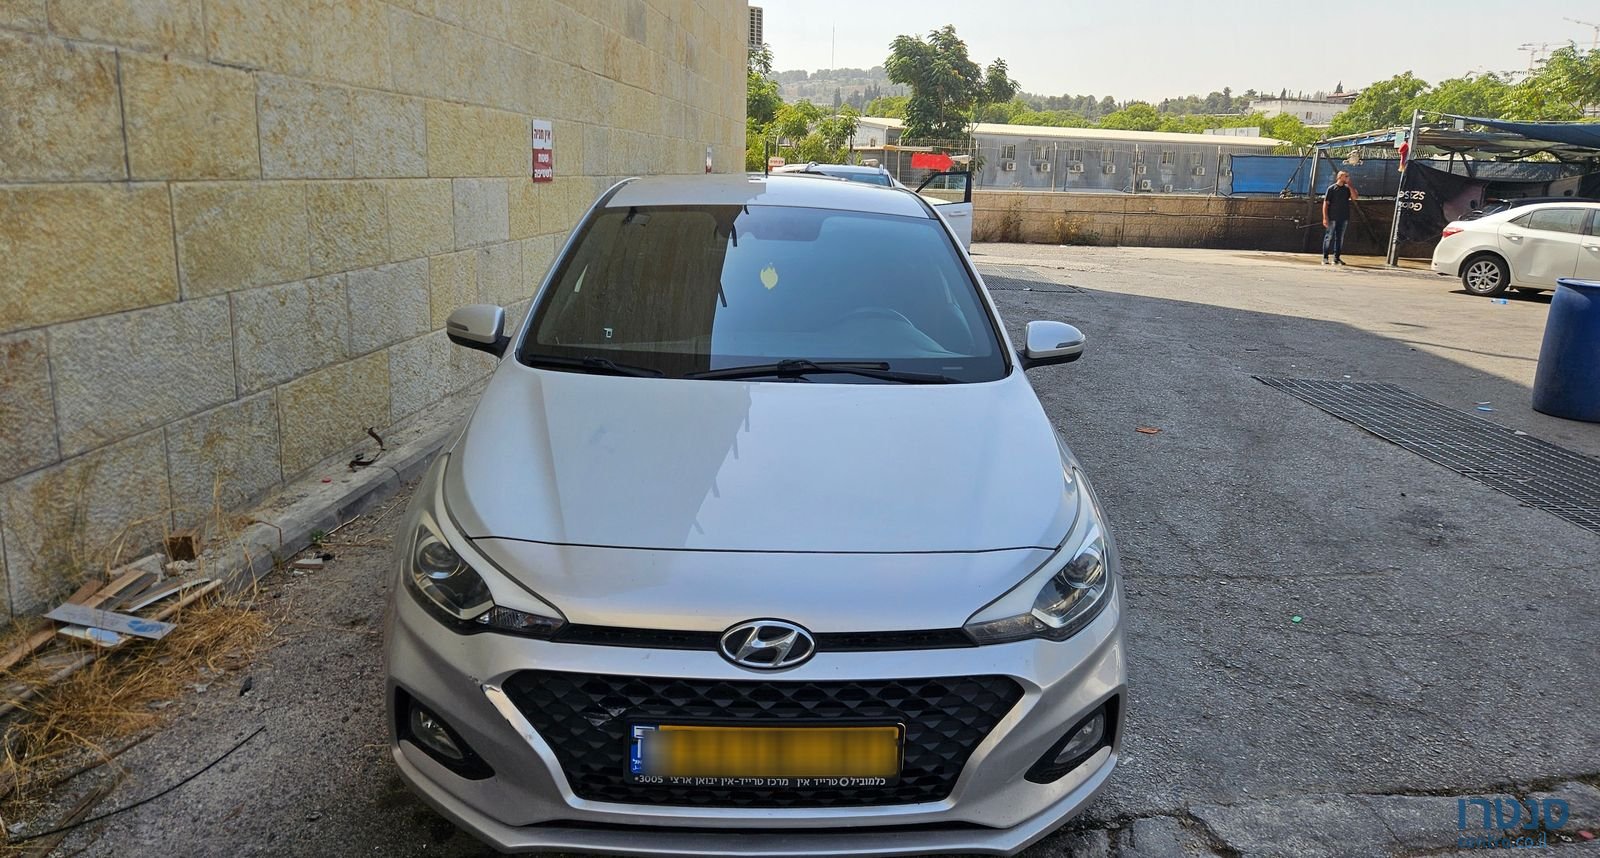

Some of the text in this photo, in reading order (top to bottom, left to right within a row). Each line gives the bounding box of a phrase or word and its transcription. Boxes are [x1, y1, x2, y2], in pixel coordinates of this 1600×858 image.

[670, 776, 692, 785] ארצי
[695, 776, 718, 786] יבואן
[767, 778, 789, 786] מרכז
[797, 778, 810, 787] אין
[814, 778, 838, 787] טרייד
[851, 776, 886, 786] כלמוביל
